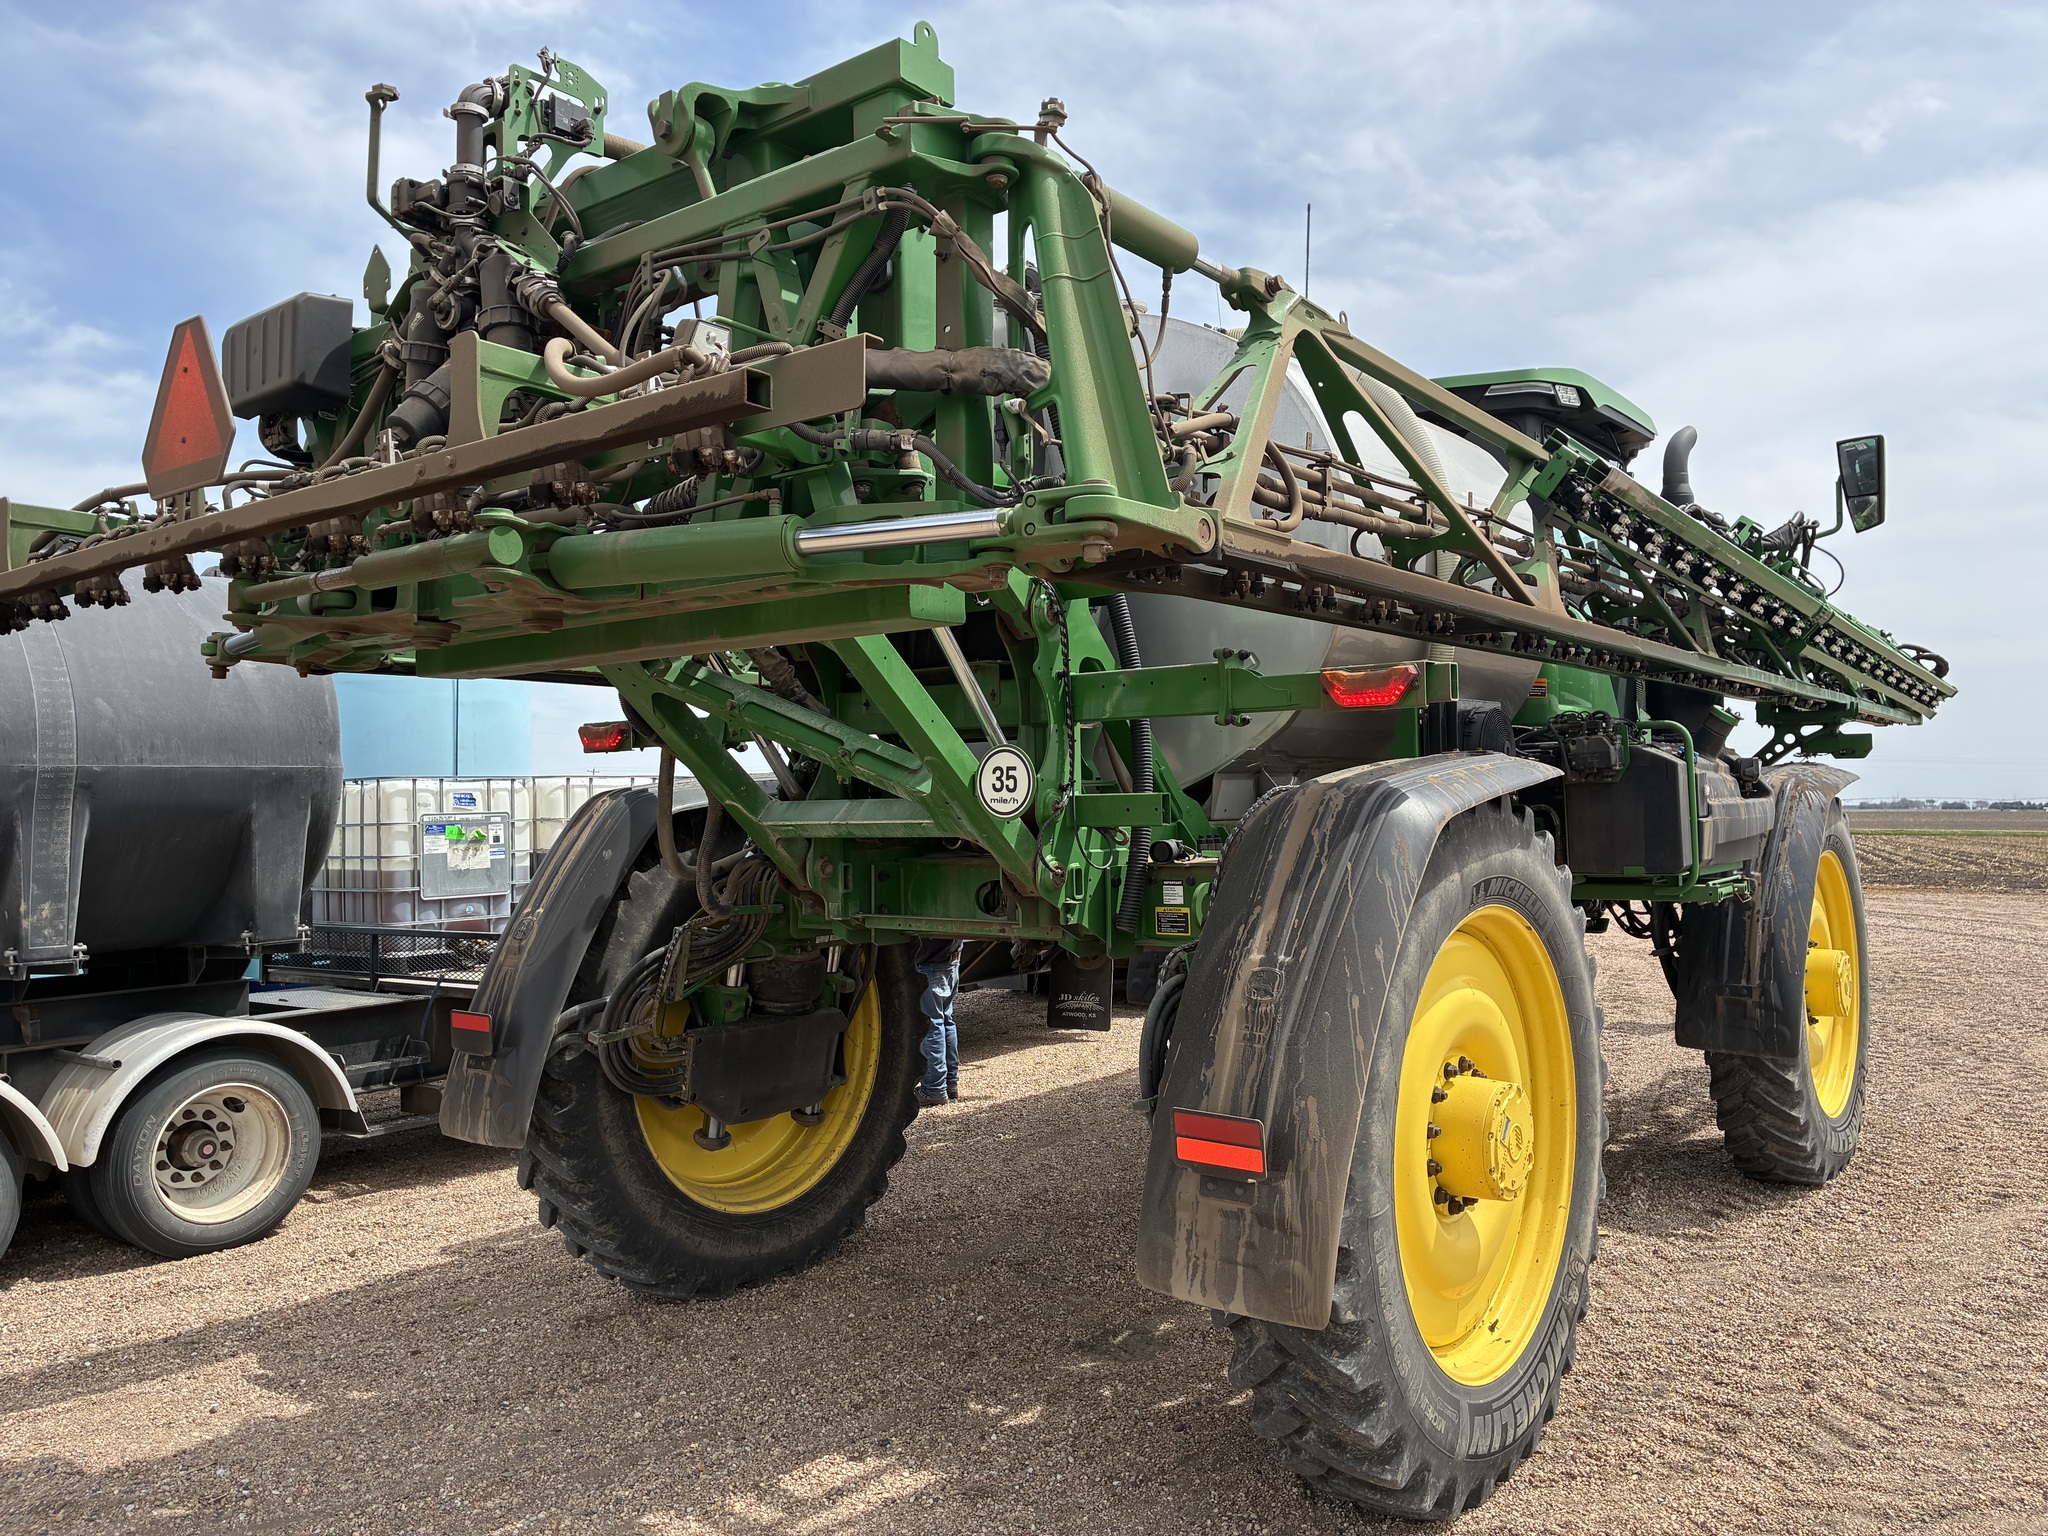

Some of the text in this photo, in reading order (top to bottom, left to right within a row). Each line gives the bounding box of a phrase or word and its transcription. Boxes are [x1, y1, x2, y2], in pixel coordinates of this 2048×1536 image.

[992, 766, 1017, 793] 35
[1487, 878, 1550, 928] MICHELIN
[1058, 992, 1101, 1002] JD skiles
[133, 1114, 157, 1186] DAYTON
[1468, 1311, 1570, 1456] MICHELIN
